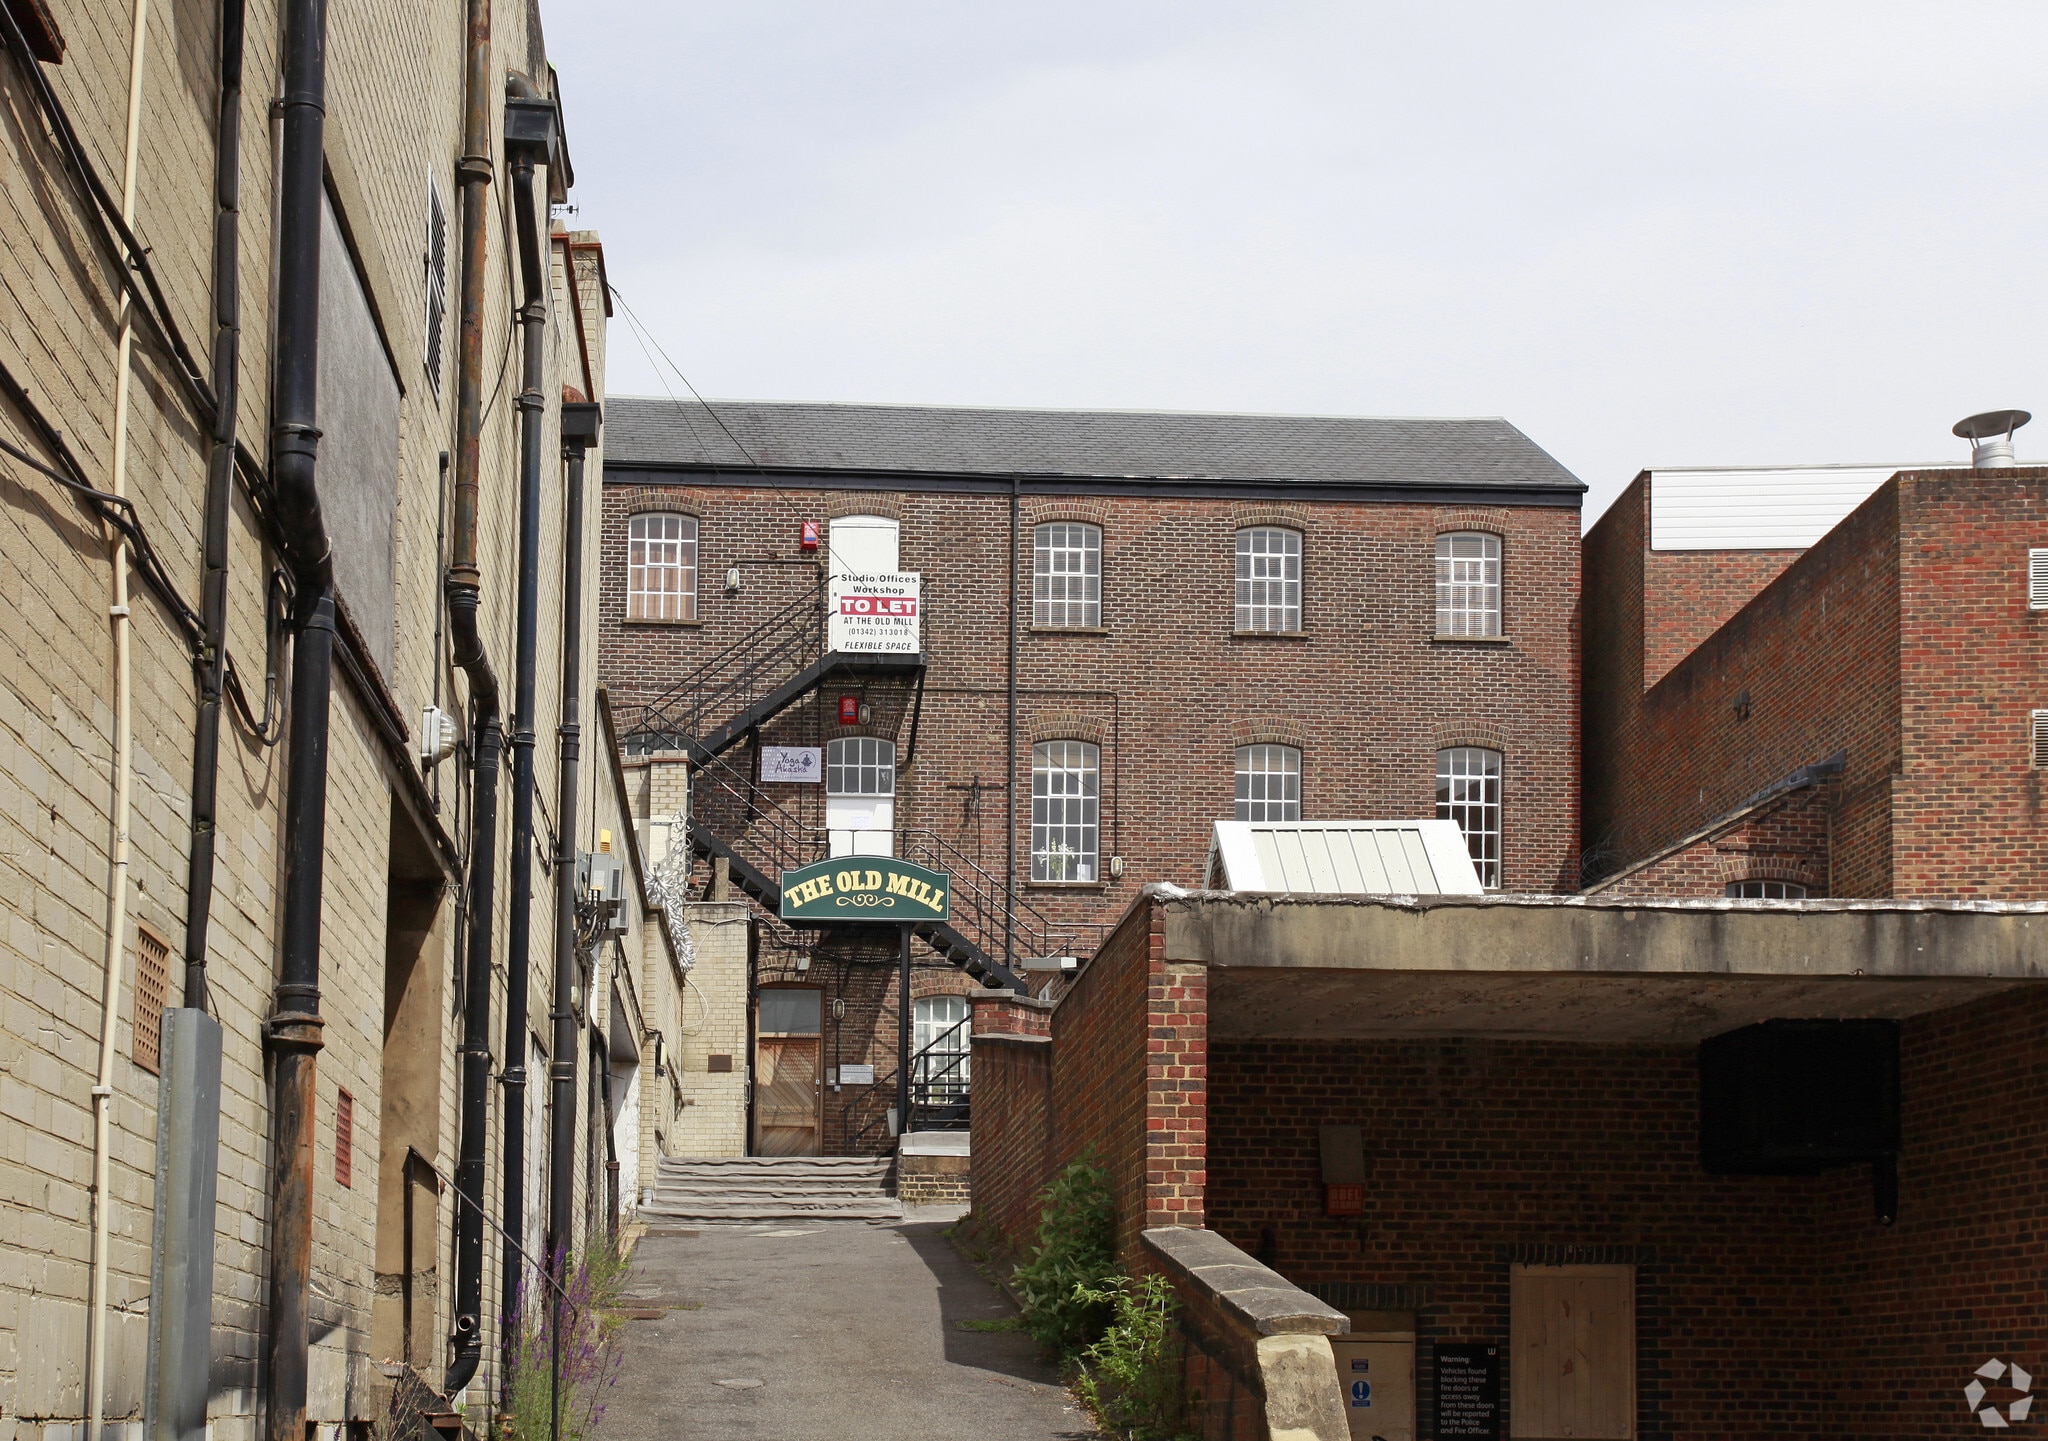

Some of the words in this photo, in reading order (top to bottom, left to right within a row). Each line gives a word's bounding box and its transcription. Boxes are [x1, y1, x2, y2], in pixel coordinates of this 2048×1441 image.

[841, 574, 917, 583] Studio/Offices
[853, 586, 905, 596] Workshop
[841, 599, 871, 613] TO
[876, 600, 916, 613] LET
[843, 617, 853, 625] AT
[857, 617, 872, 625] THE
[875, 617, 891, 625] OLD
[894, 617, 913, 626] MILL
[848, 628, 876, 636] (01342)
[879, 628, 909, 636] 313018
[844, 641, 883, 650] FLEXIBLE
[885, 642, 912, 650] SPACE
[780, 752, 800, 767] Yoga
[783, 874, 834, 909] THE
[836, 870, 883, 893] OLD
[885, 872, 945, 913] MILL
[1329, 1188, 1360, 1200] ABEL
[1440, 1355, 1471, 1364] Warning:
[1440, 1367, 1467, 1375] Vehicles
[1467, 1367, 1487, 1375] found
[1440, 1376, 1468, 1384] blocking
[1440, 1384, 1452, 1392] fire
[1452, 1384, 1471, 1392] doors
[1440, 1401, 1457, 1409] from
[1462, 1410, 1490, 1418] reported
[1461, 1418, 1480, 1426] Police
